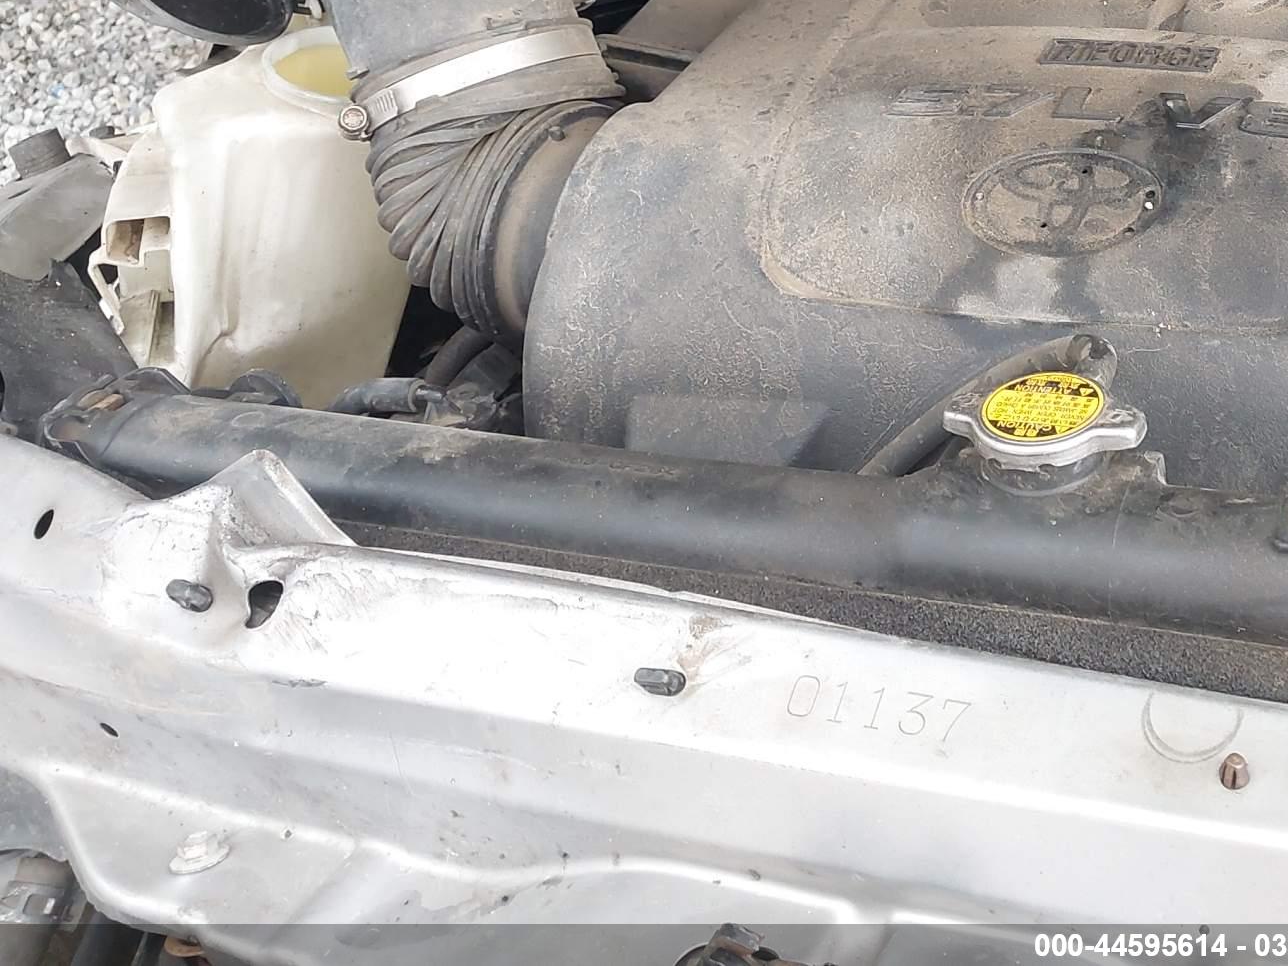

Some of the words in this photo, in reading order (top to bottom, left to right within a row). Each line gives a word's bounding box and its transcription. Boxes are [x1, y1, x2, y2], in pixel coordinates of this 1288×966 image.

[1014, 384, 1073, 395] ATTENTION
[997, 420, 1052, 432] CAUTION
[786, 674, 973, 742] 01137
